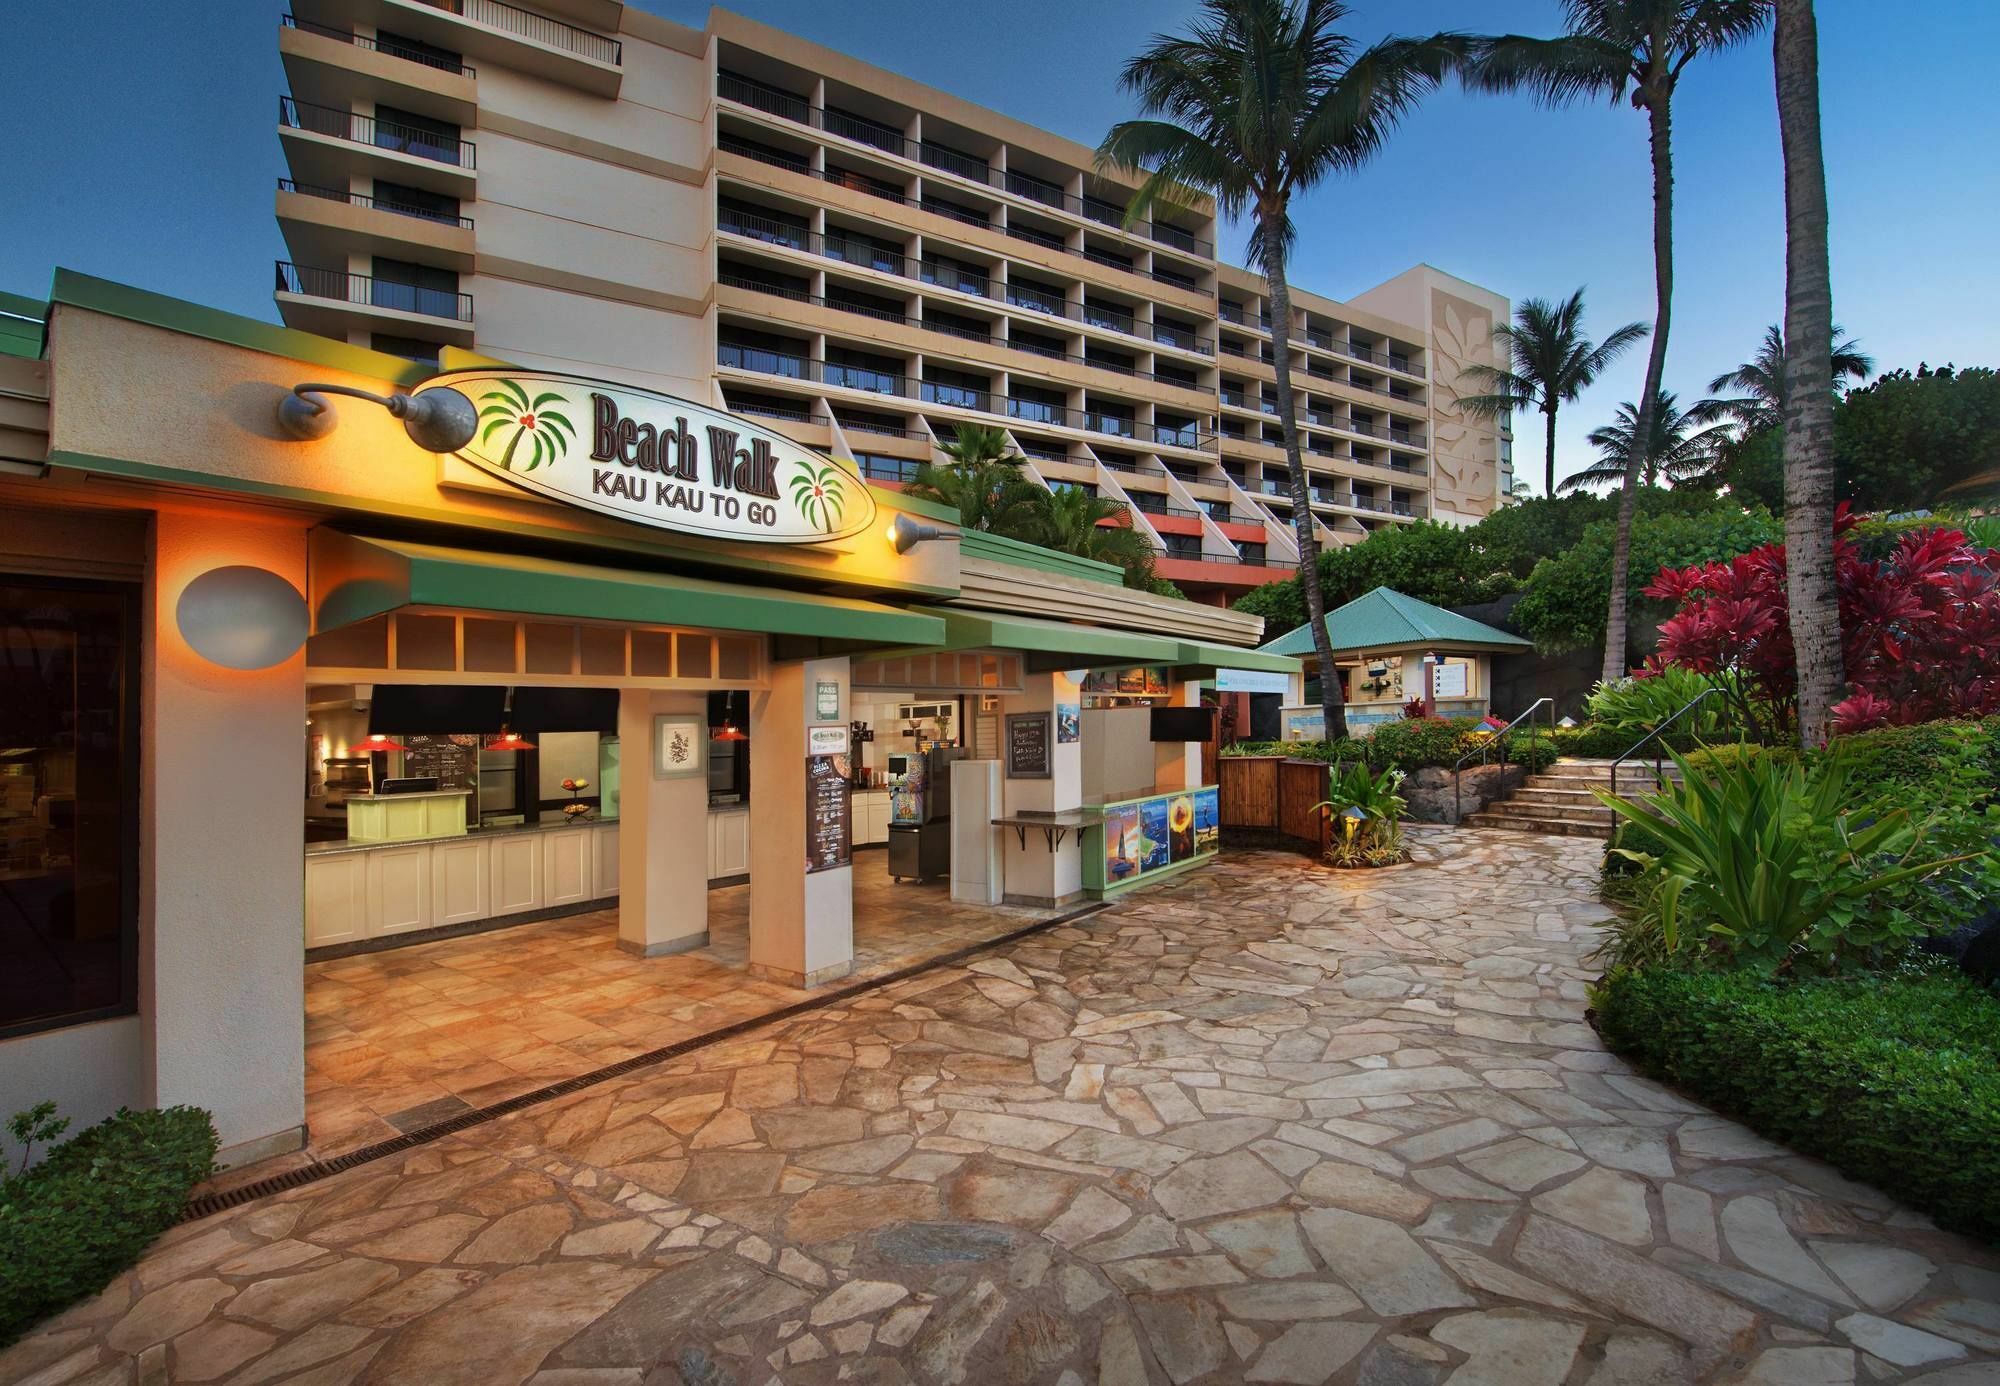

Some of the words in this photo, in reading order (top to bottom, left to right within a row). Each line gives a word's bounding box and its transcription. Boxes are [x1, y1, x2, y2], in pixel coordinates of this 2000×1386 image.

[590, 392, 699, 482] Beach
[706, 424, 781, 500] Walk
[592, 468, 647, 502] KAU
[655, 481, 704, 513] KAU
[709, 492, 740, 520] TO
[747, 501, 777, 527] GO
[819, 686, 837, 694] PASS
